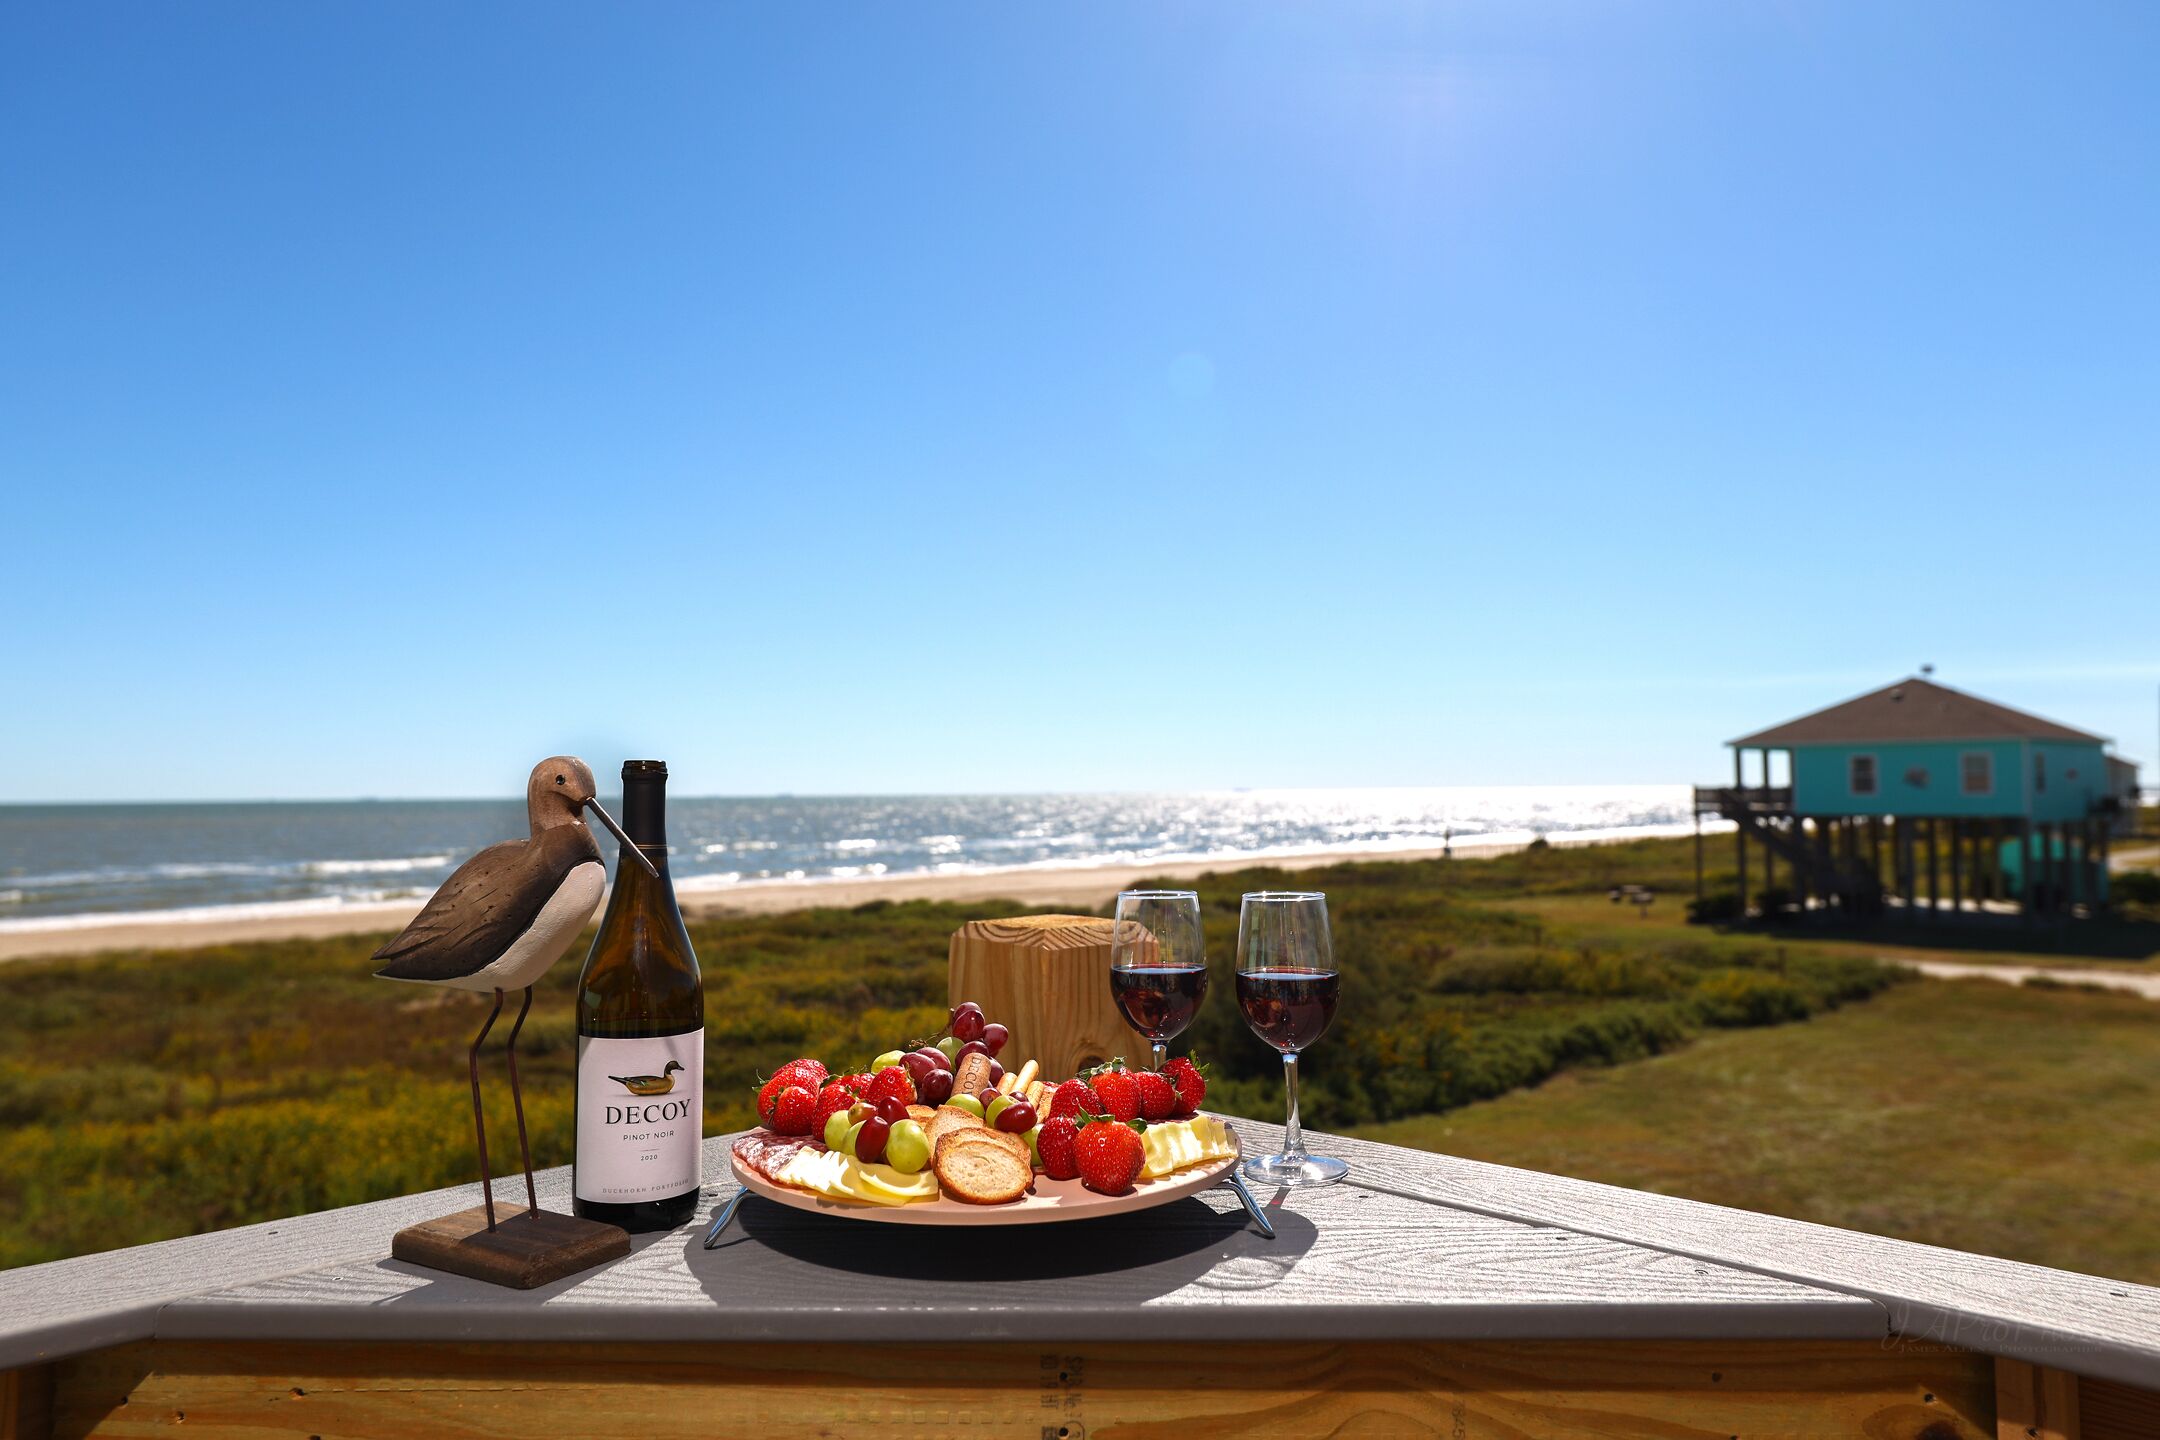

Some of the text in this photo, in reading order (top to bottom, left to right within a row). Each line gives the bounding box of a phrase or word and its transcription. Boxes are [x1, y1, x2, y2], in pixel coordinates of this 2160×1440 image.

[961, 1056, 982, 1096] DECO
[605, 1098, 691, 1125] DECOY
[623, 1130, 675, 1141] PINOT NOIR
[651, 1178, 689, 1192] PORTFOLIO
